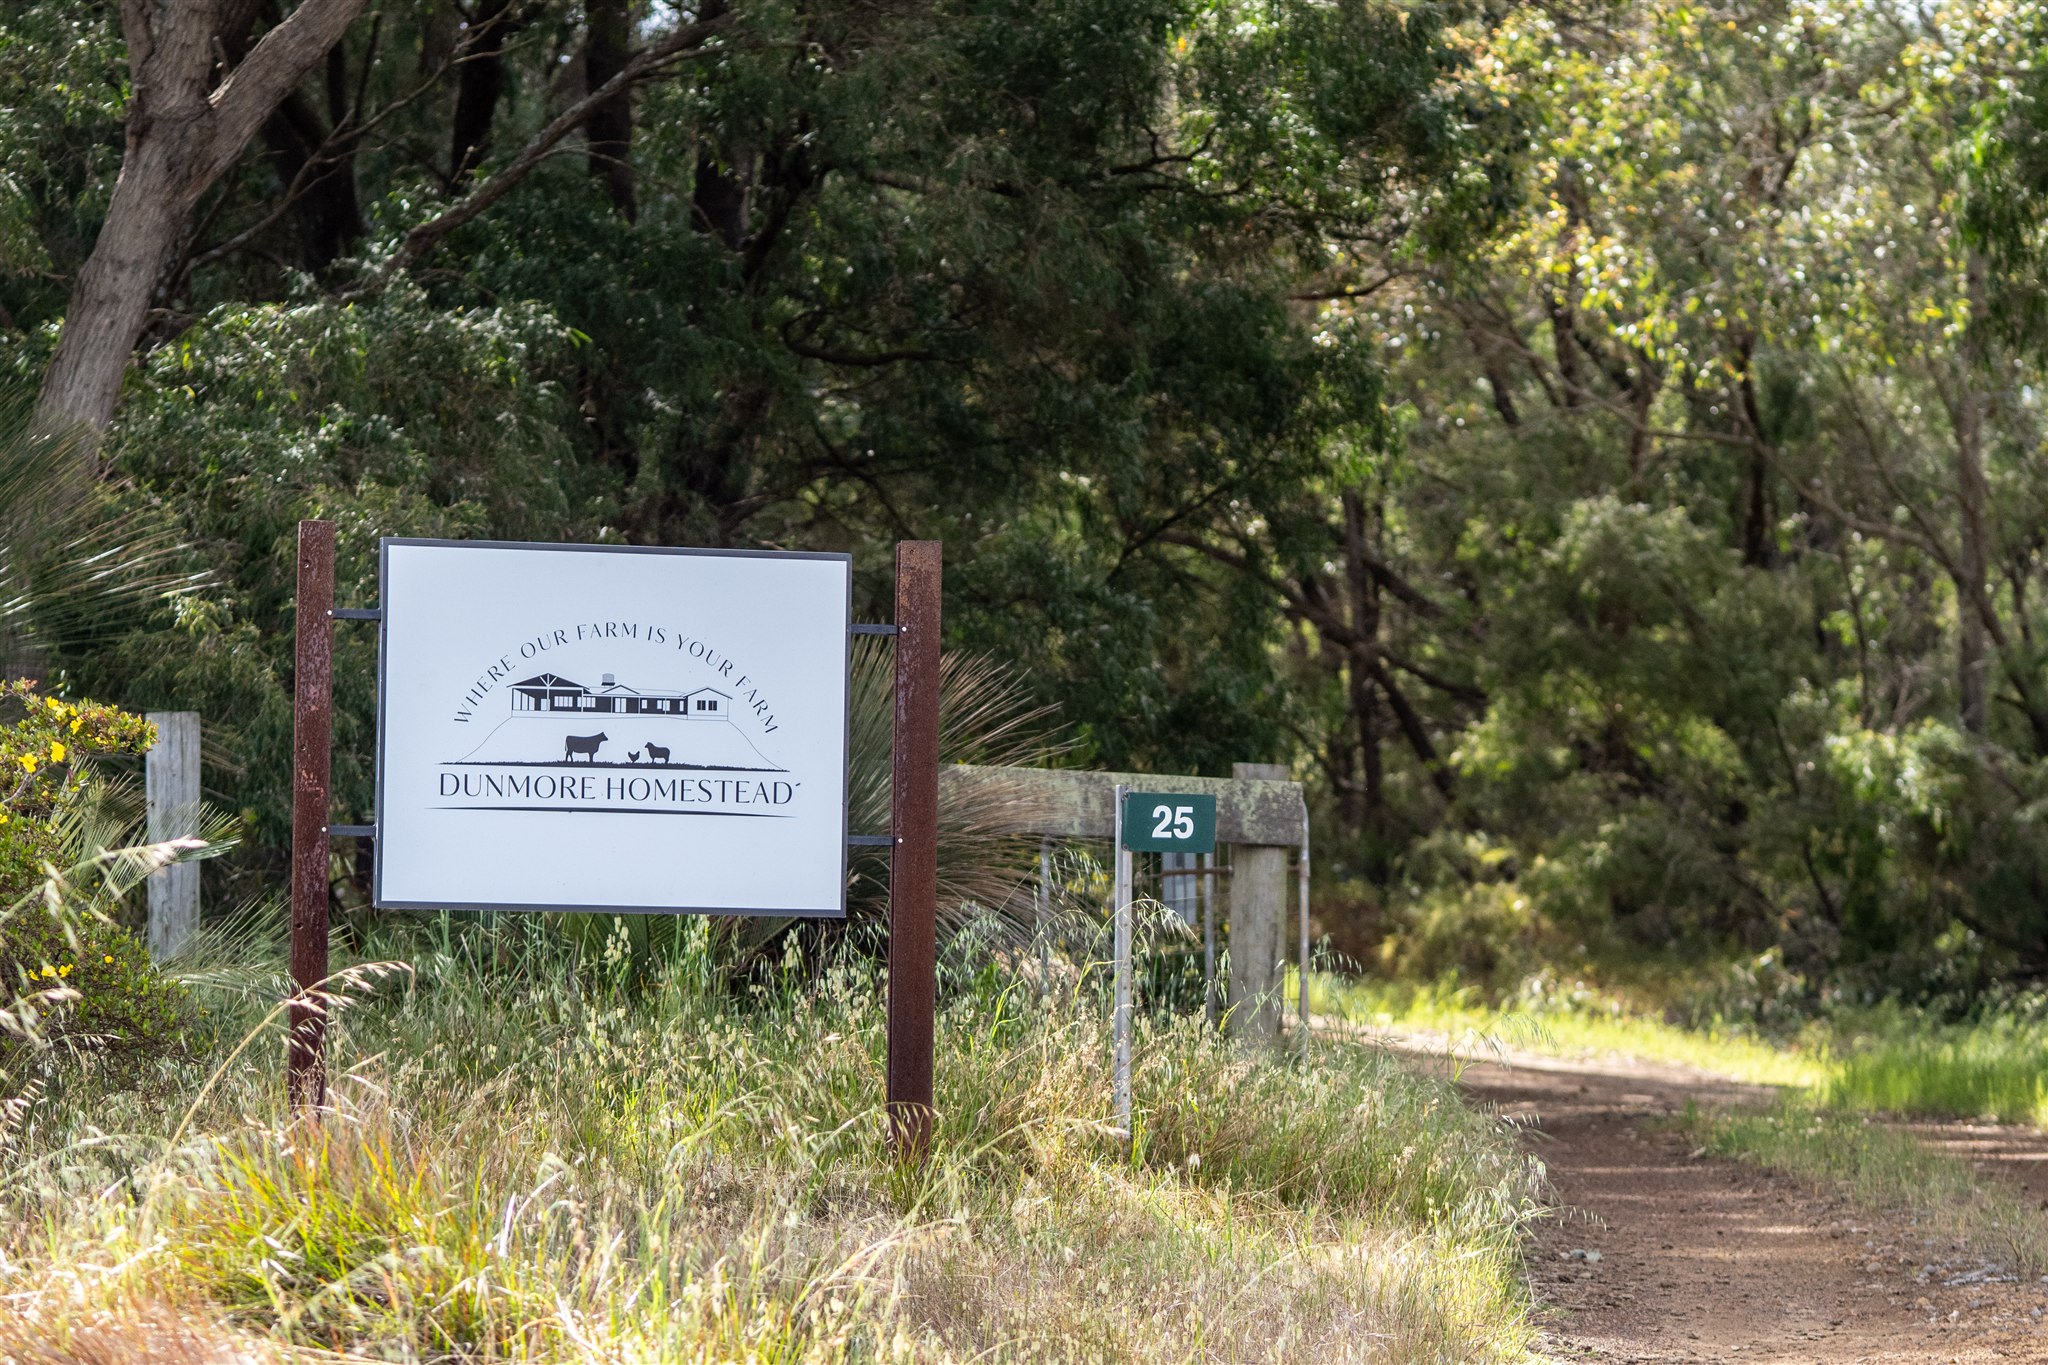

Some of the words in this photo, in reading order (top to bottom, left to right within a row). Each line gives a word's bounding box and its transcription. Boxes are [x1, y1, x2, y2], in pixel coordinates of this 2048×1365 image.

[454, 655, 516, 724] WHERE
[520, 629, 568, 659] OUR
[577, 621, 637, 641] FARM
[648, 626, 665, 644] IS
[677, 633, 734, 678] YOUR
[736, 675, 779, 734] FARM
[439, 773, 596, 800] DUNMORE
[606, 777, 794, 806] HOMESTEAD
[1152, 805, 1194, 839] 25
